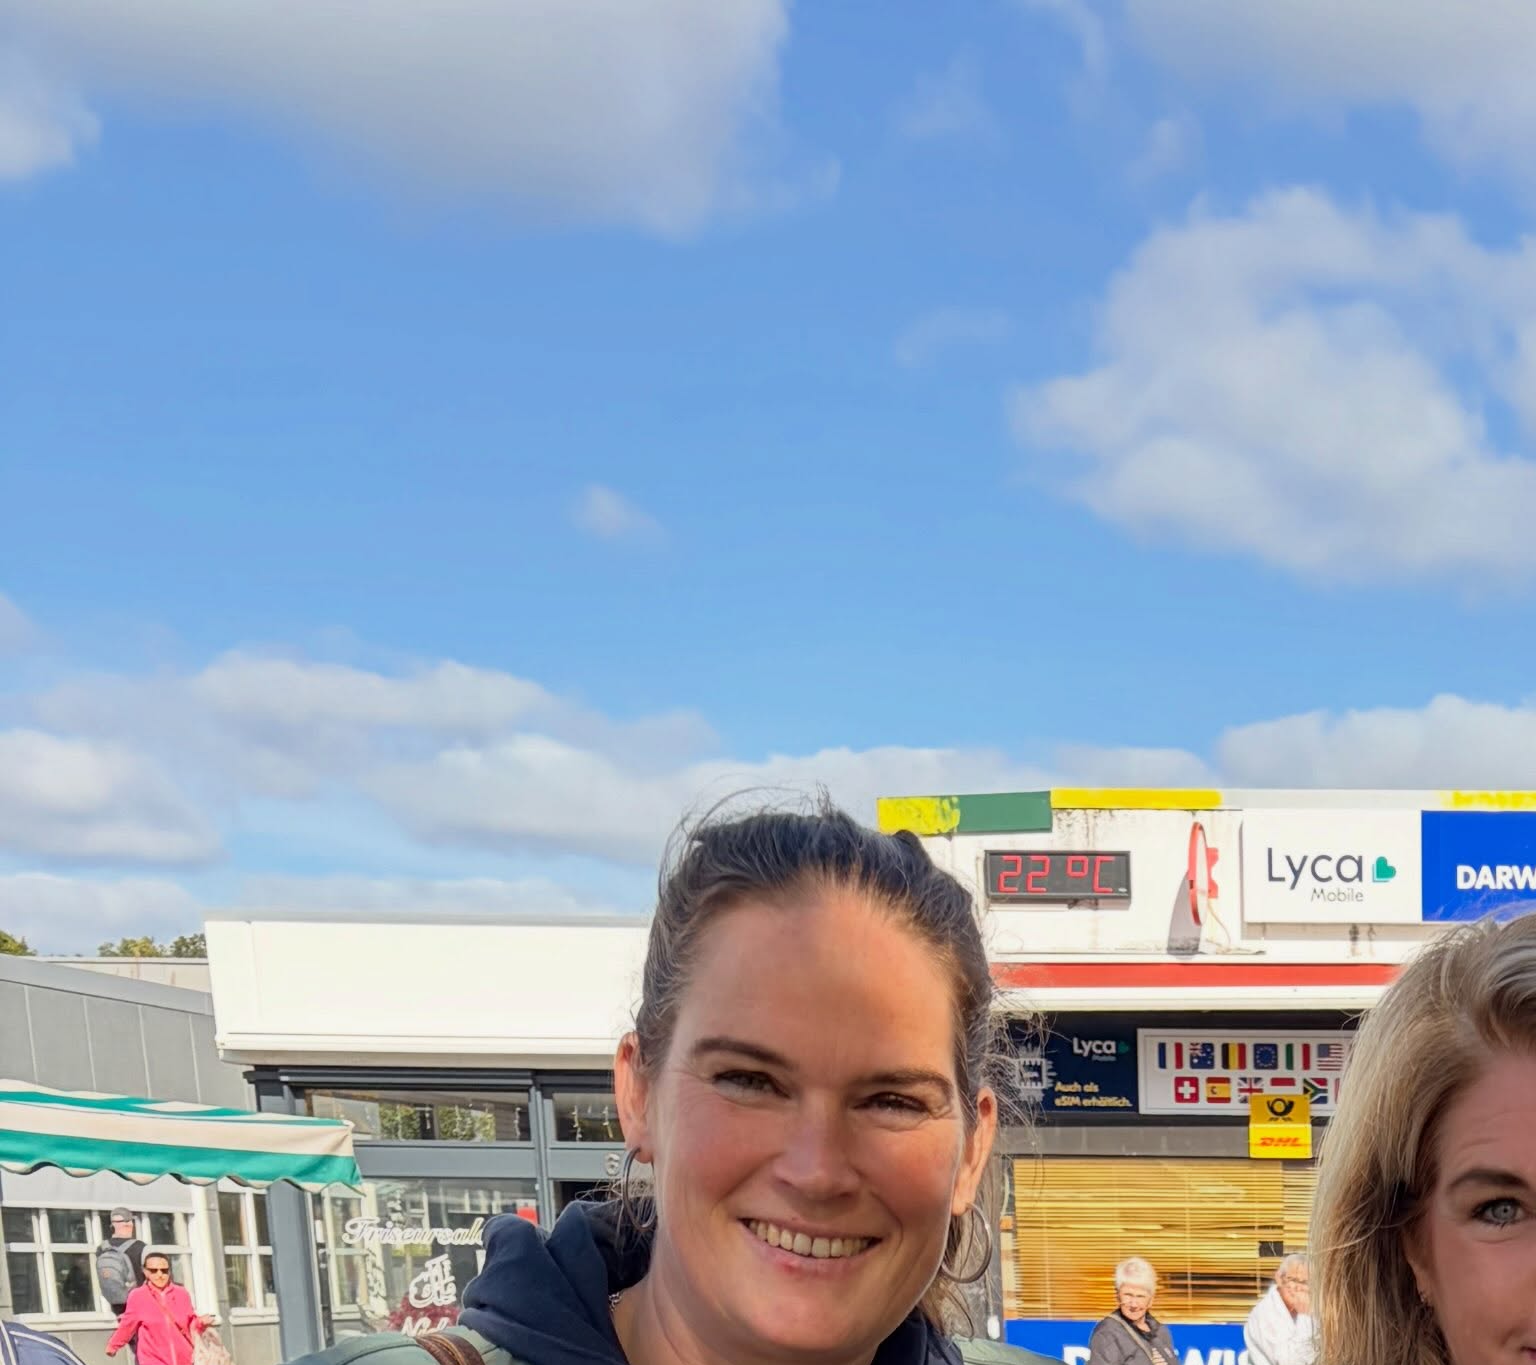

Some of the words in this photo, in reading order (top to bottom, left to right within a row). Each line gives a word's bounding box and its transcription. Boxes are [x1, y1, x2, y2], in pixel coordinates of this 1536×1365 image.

[996, 855, 1050, 894] 22
[1267, 846, 1363, 891] Lyca
[1310, 888, 1365, 903] Mobile
[1072, 1037, 1117, 1058] Lyca
[1259, 1137, 1303, 1147] DHL
